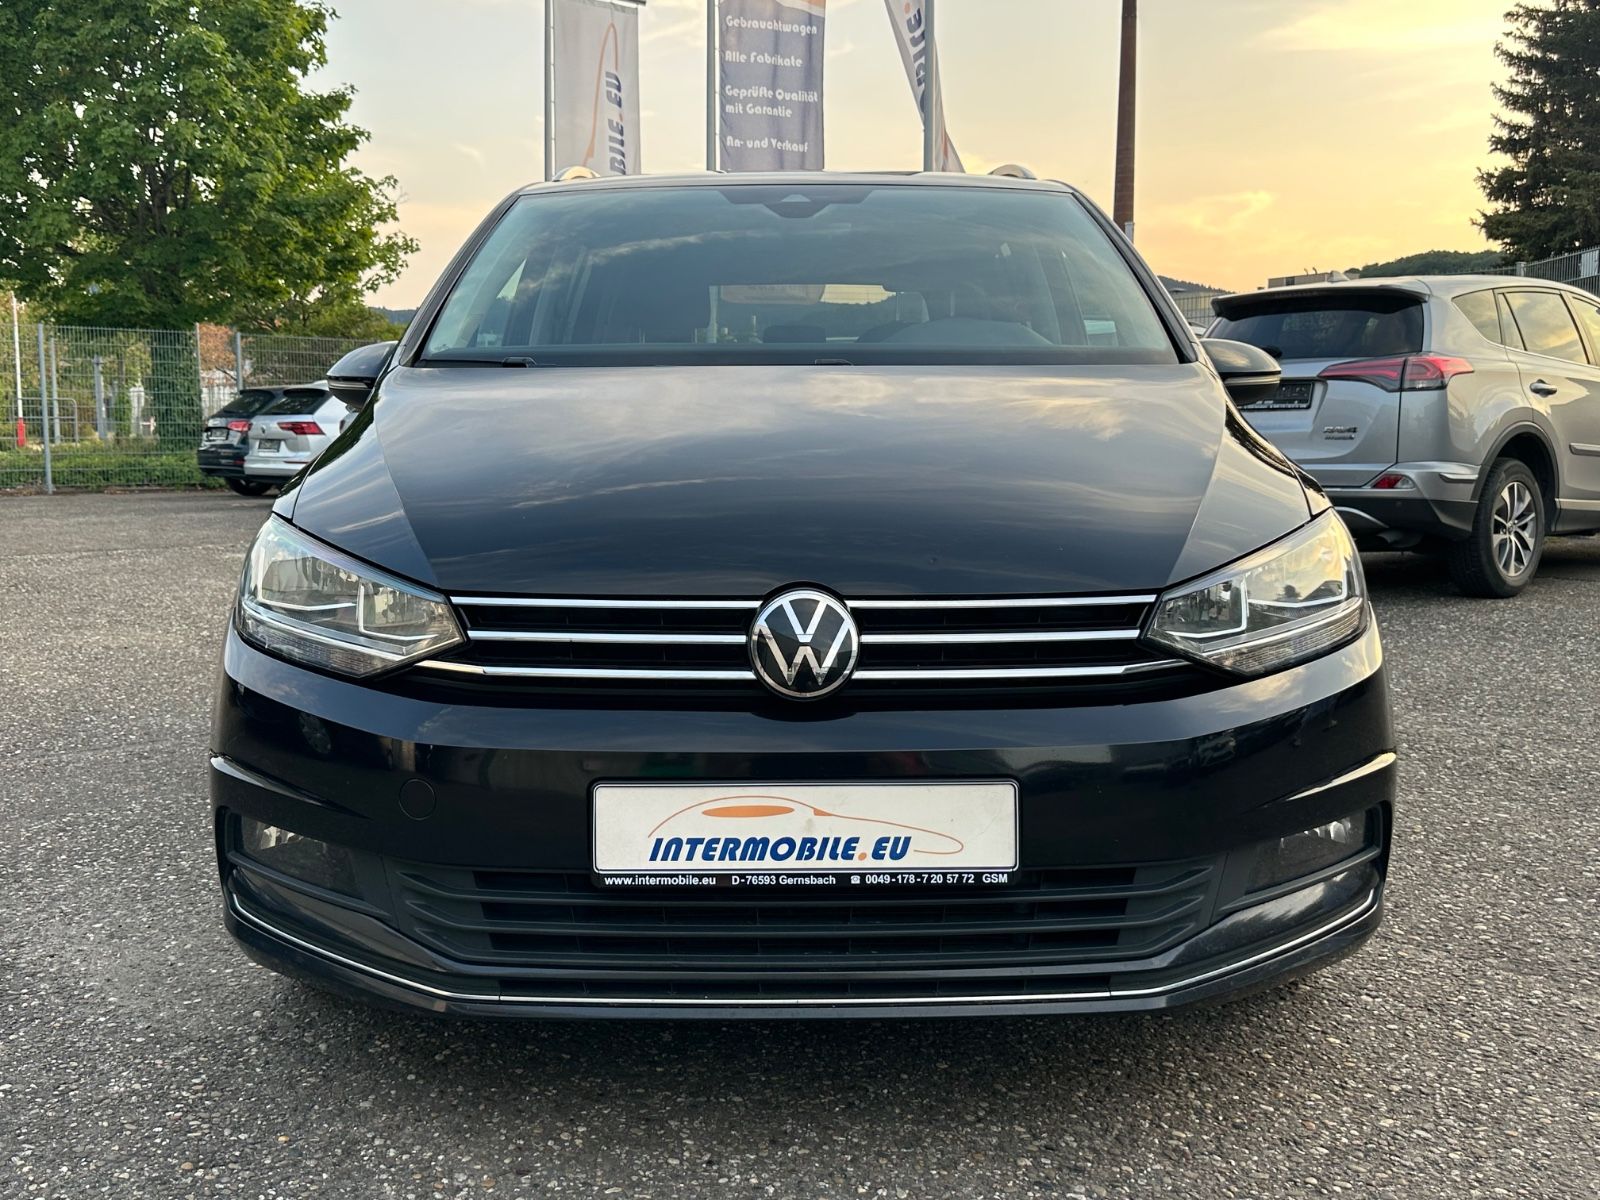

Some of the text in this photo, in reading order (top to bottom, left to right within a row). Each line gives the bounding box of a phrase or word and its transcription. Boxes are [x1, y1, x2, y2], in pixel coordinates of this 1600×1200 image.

[725, 15, 818, 37] Gebrauchtwagen
[725, 50, 803, 68] Alle Fabrikate
[725, 85, 819, 103] Geprüfte Qualität
[725, 103, 793, 118] mit Garantie
[726, 135, 809, 153] An- und Verkauf
[648, 836, 912, 862] INTERMOBILE.EU
[604, 875, 717, 886] www.intermobile.eu
[731, 875, 777, 886] D-76593
[778, 874, 837, 886] Gernsbach
[961, 874, 975, 884] 72
[982, 873, 1009, 884] GSM
